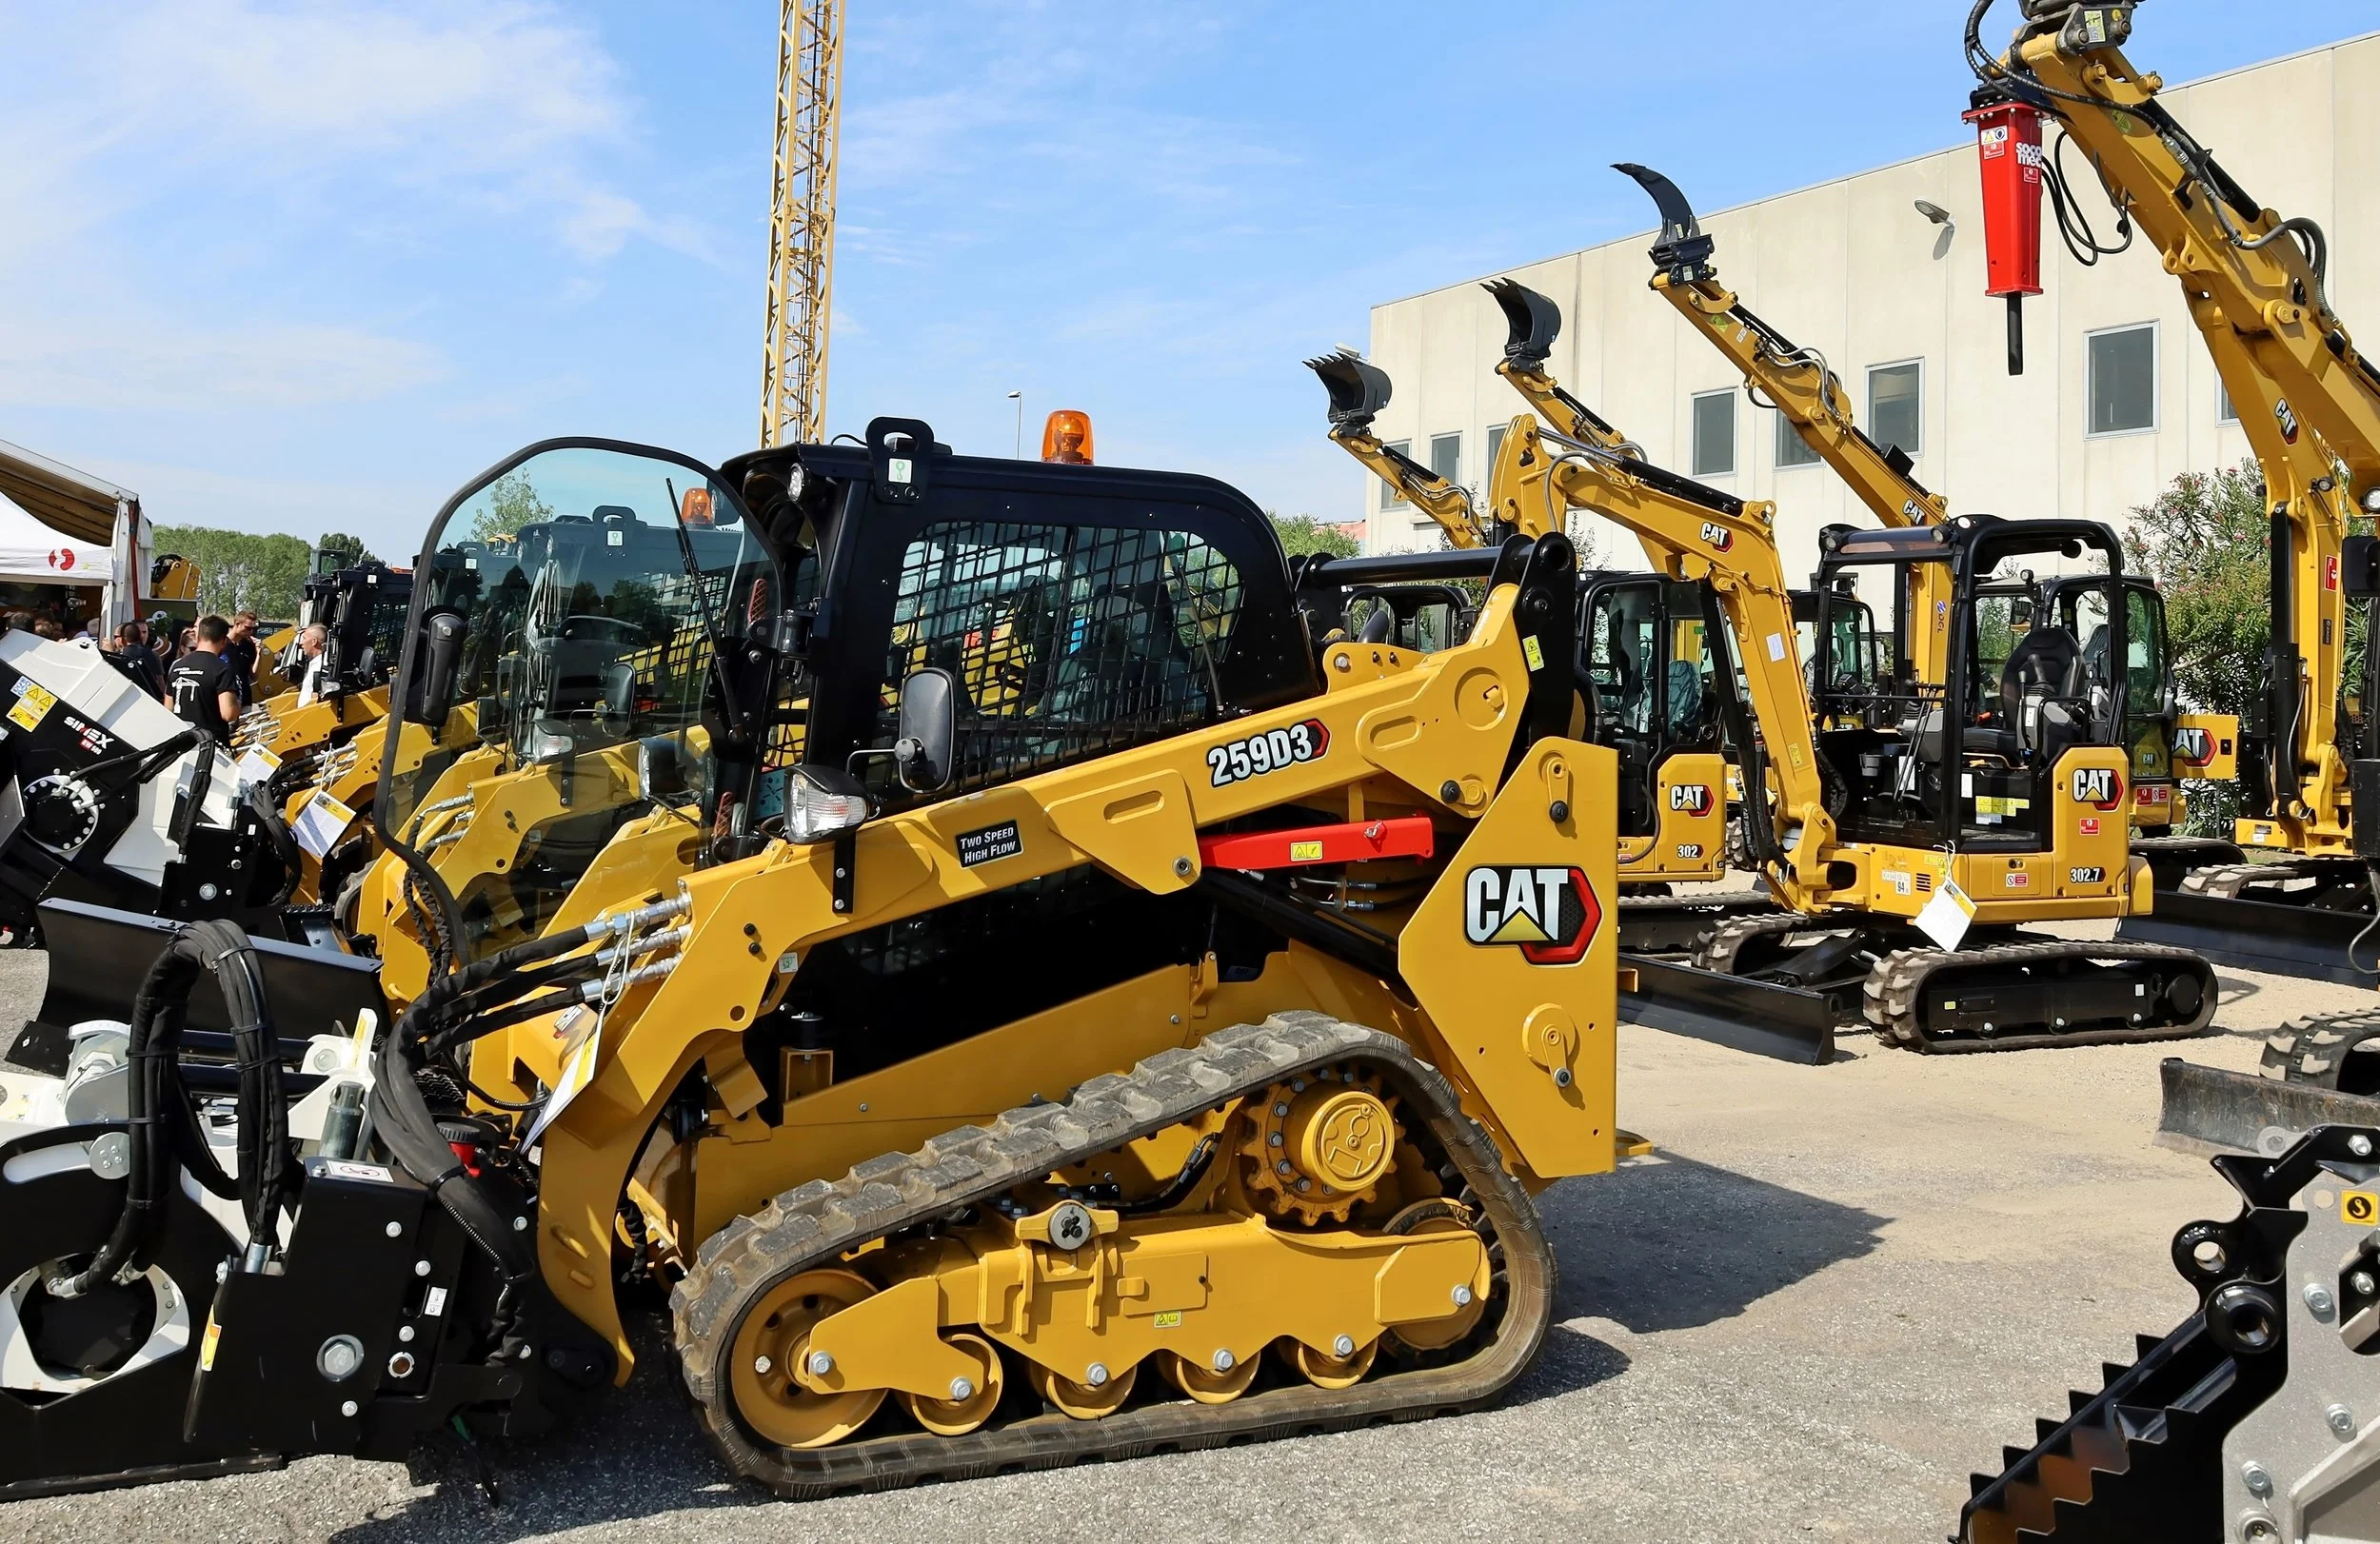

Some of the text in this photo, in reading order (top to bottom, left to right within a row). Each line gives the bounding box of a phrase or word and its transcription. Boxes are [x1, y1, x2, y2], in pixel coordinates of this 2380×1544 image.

[2275, 399, 2297, 435] CAT
[1903, 498, 1925, 525] CAT
[1700, 522, 1728, 546] CAT
[63, 716, 114, 749] SIMEX
[2172, 728, 2204, 758] AT
[1208, 724, 1313, 785] 259D3
[1671, 785, 1704, 810] CAT
[2073, 769, 2112, 802] CAT
[960, 826, 1014, 850] TWO SPEED
[1677, 844, 1698, 858] 302
[964, 841, 1016, 863] HIGH FLOW
[2071, 867, 2100, 881] 302.7
[1467, 867, 1569, 942] CAT
